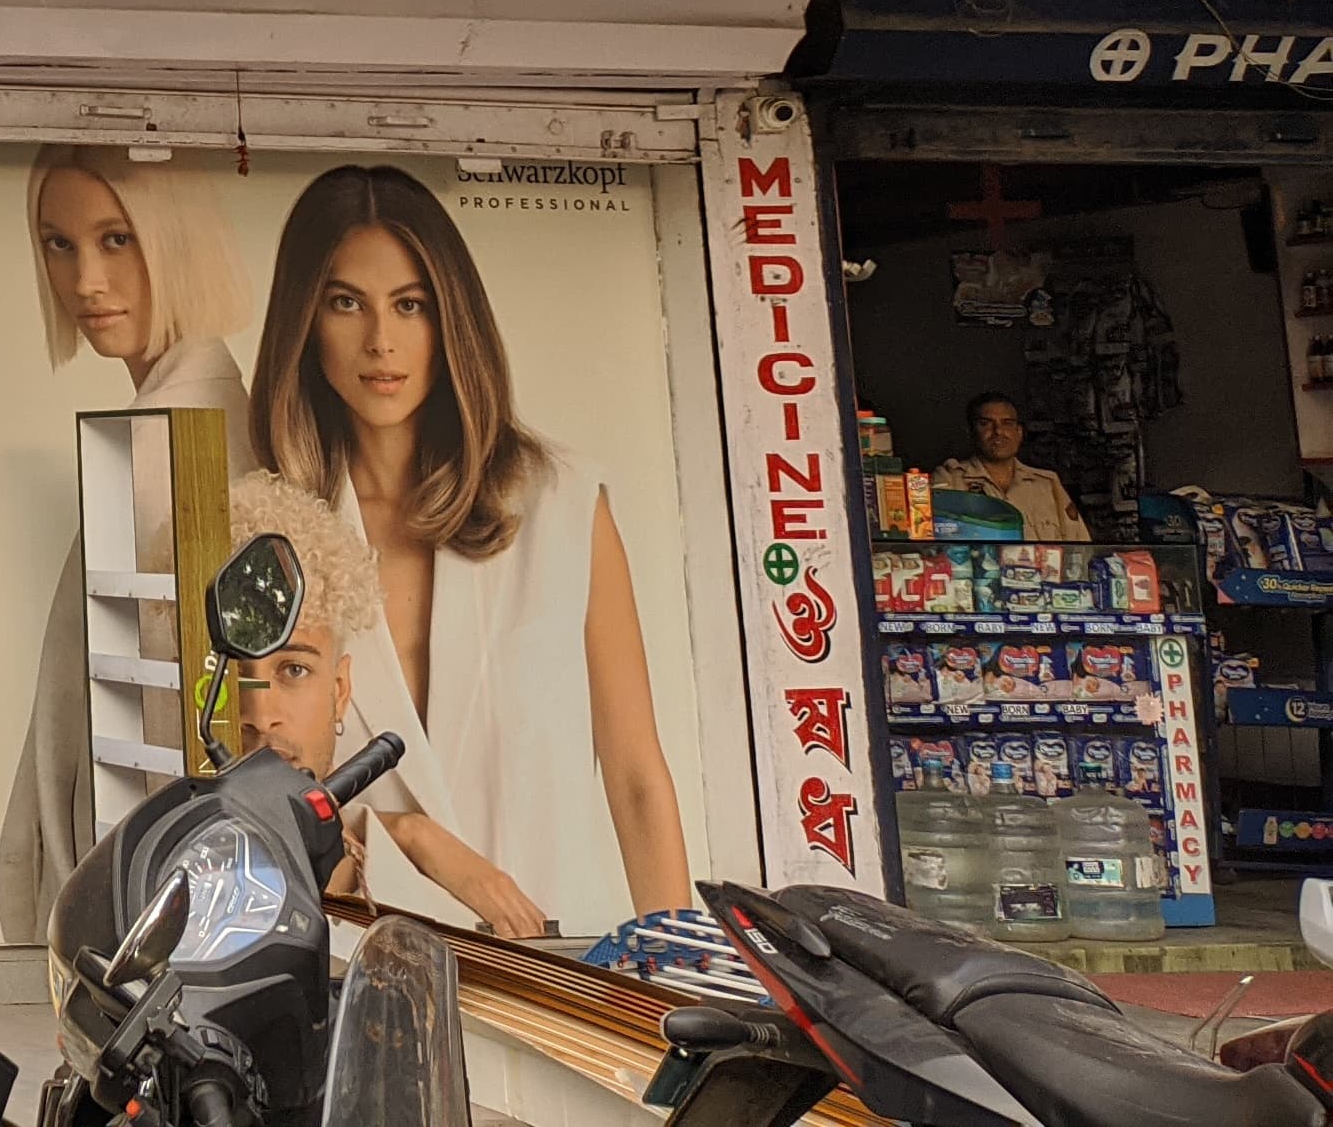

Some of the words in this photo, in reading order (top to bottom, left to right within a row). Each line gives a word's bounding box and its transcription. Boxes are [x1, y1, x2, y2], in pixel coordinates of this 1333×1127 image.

[460, 196, 630, 211] PROFESSIONAL
[738, 156, 827, 541] MEDICINE
[926, 623, 955, 633] BORN
[1032, 623, 1055, 633] NEW
[1085, 623, 1114, 633] BORN
[1136, 624, 1163, 634] BABY
[947, 704, 969, 714] NEW
[1002, 705, 1029, 715] BORN
[1062, 704, 1088, 714] BABY
[1167, 673, 1202, 885] PHARMACY
[744, 928, 779, 954] 150
